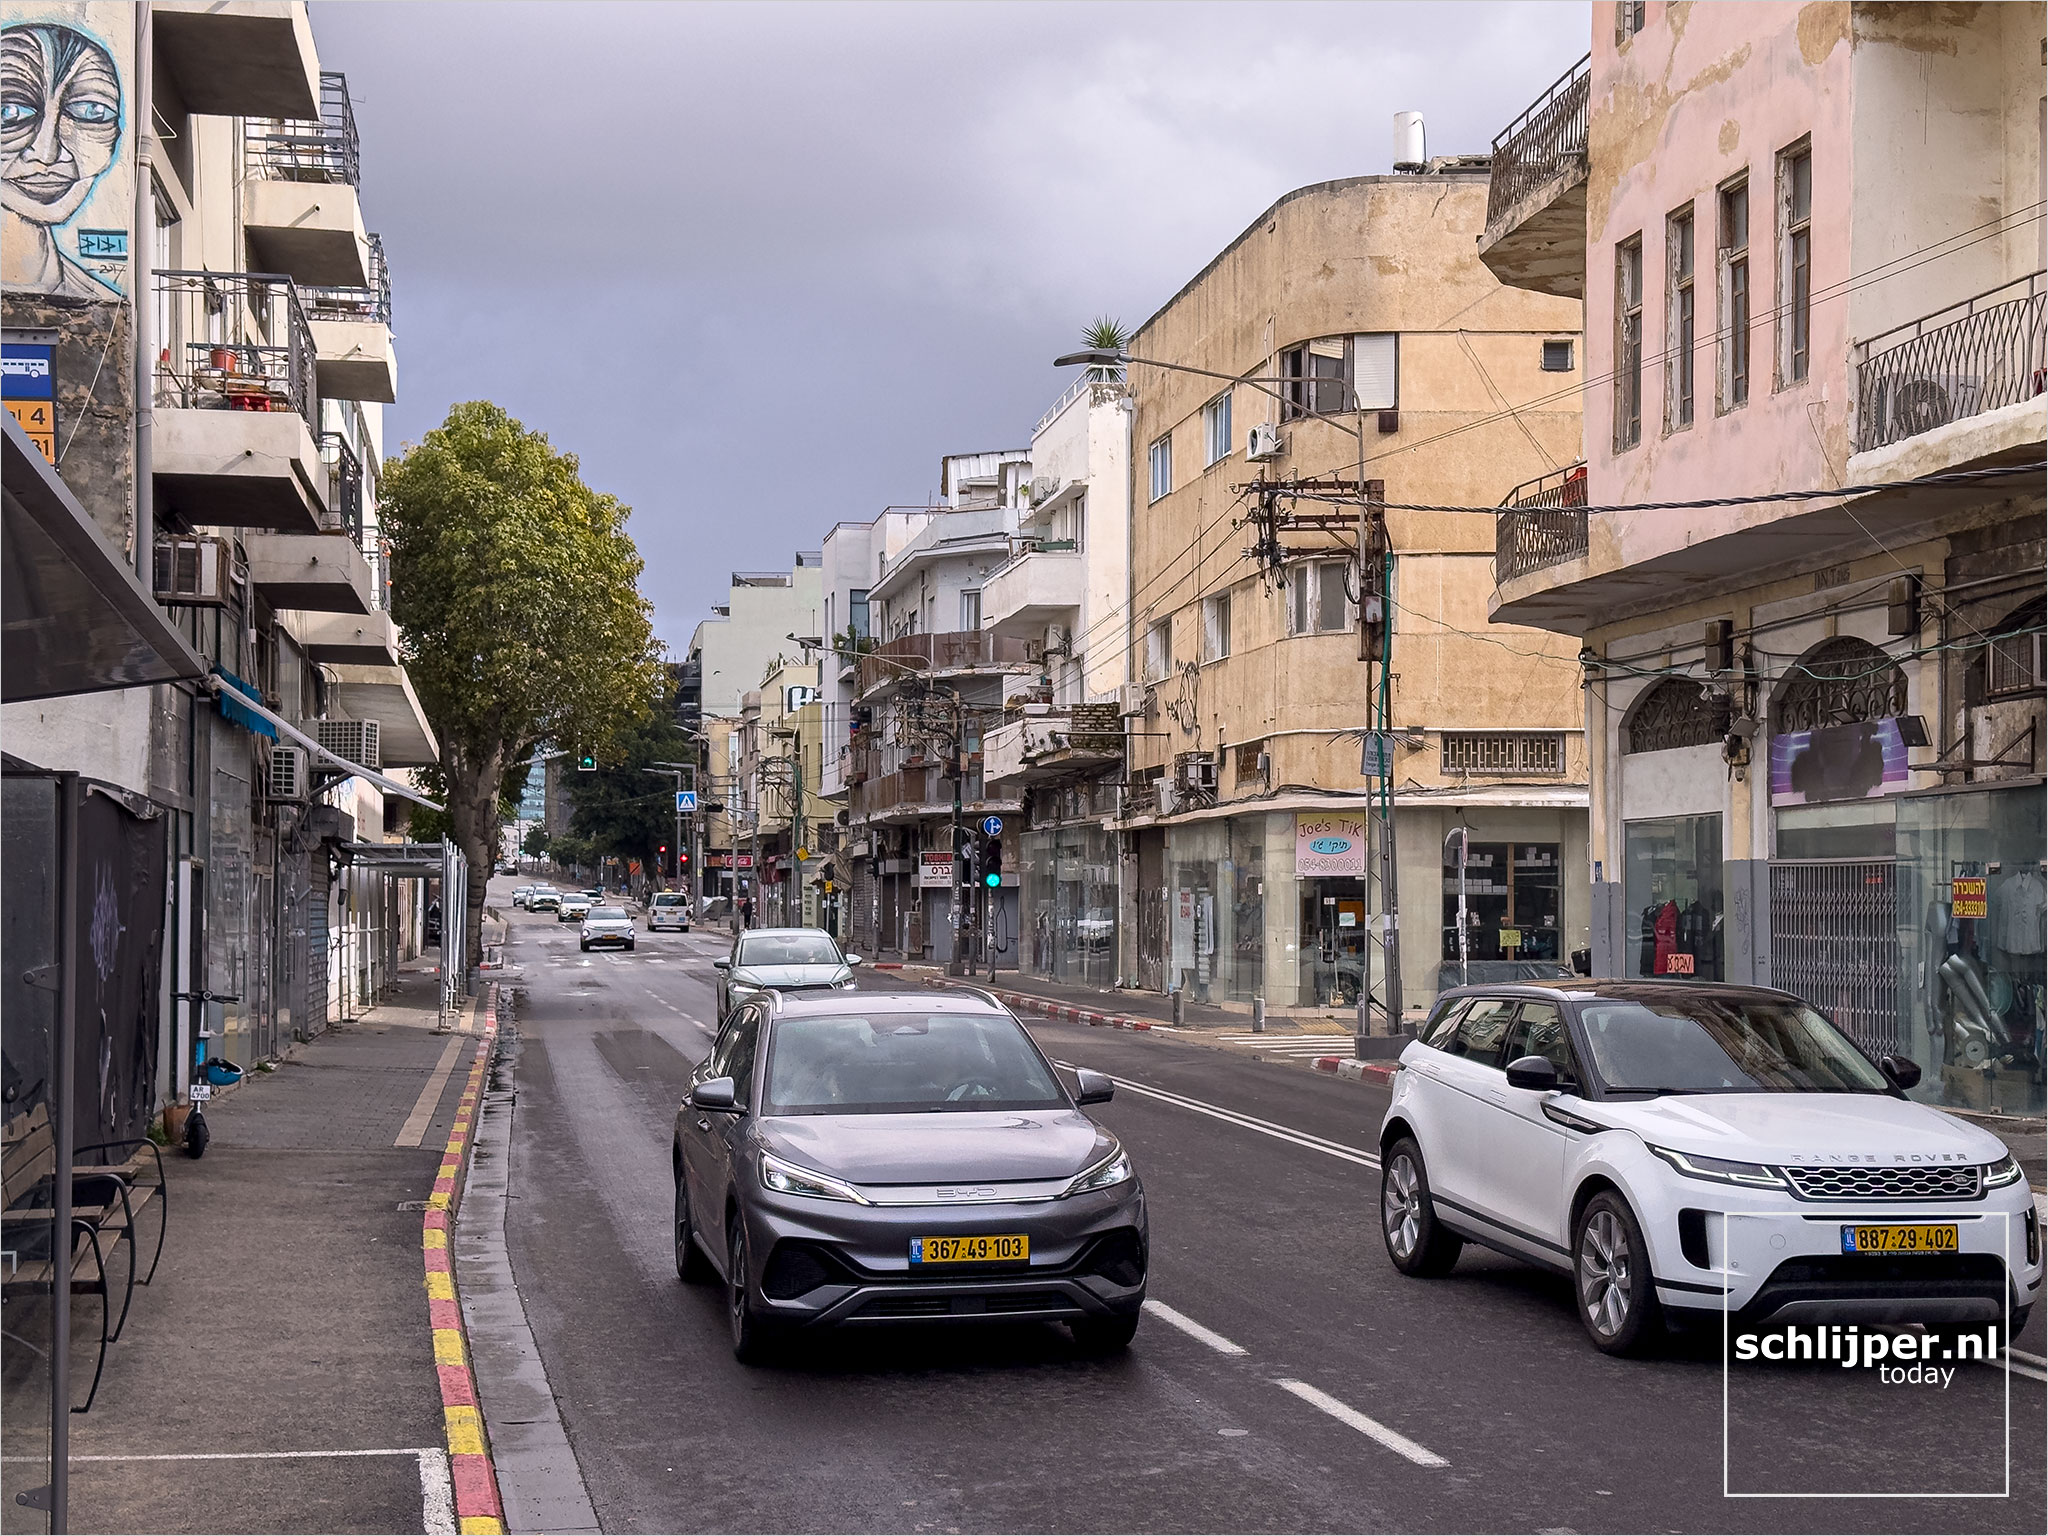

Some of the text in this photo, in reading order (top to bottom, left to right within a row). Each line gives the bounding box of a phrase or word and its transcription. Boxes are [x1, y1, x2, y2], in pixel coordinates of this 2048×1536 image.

[30, 407, 46, 425] 4
[1299, 818, 1331, 838] Joe's
[1953, 879, 1986, 895] להשכרה
[1791, 1153, 1968, 1162] RANGE ROVER
[936, 1187, 997, 1198] BYD
